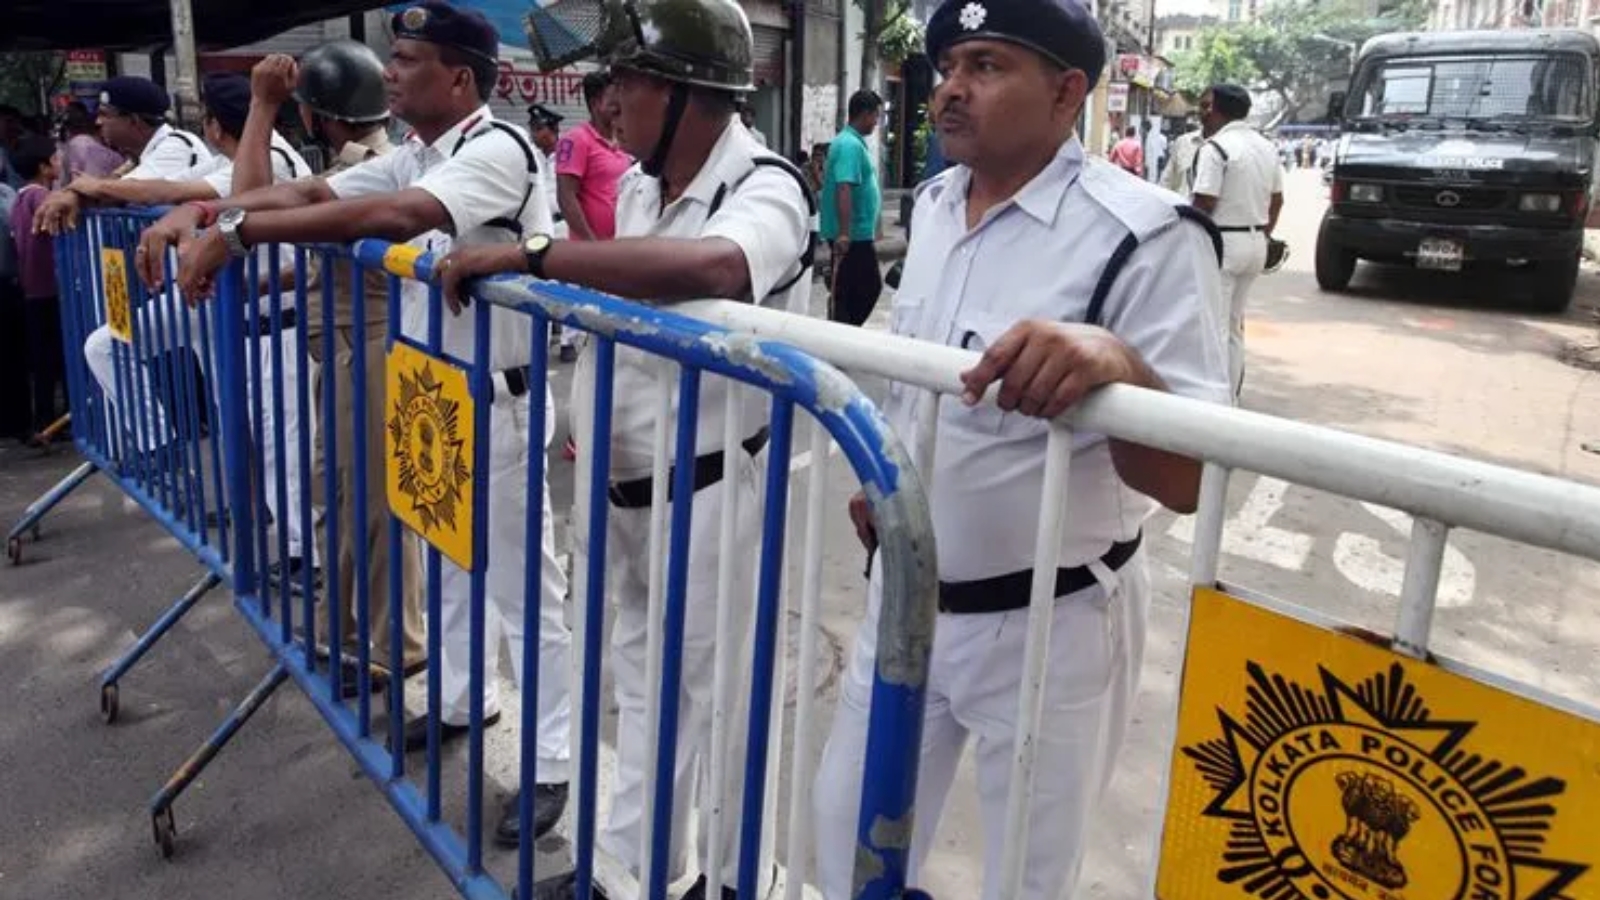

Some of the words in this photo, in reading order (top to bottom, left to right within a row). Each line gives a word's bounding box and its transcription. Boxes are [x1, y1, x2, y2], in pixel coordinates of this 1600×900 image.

[1465, 156, 1504, 170] POLICE
[1258, 729, 1341, 837] KOLKATA
[1361, 733, 1486, 833] POLICE
